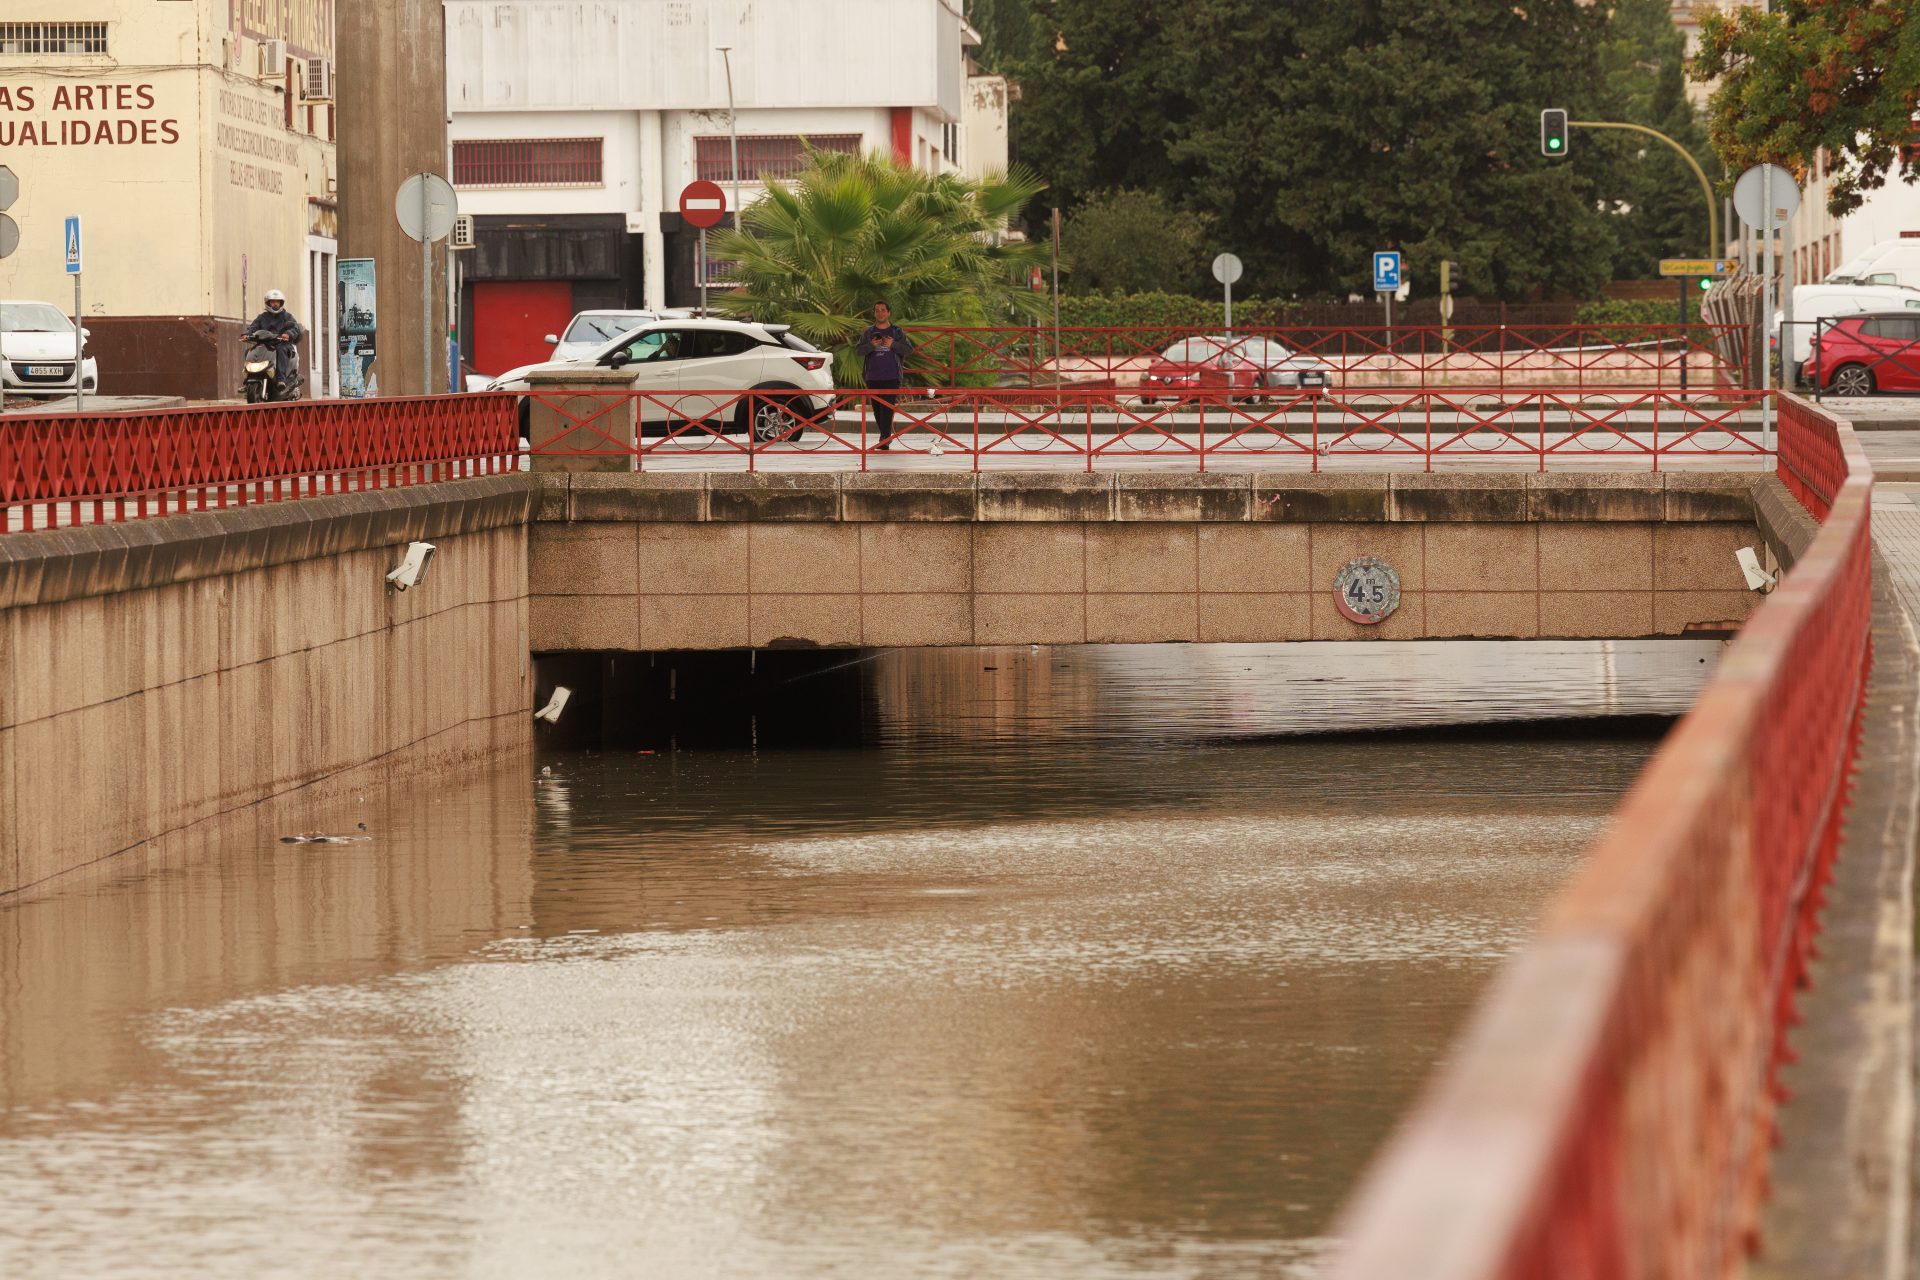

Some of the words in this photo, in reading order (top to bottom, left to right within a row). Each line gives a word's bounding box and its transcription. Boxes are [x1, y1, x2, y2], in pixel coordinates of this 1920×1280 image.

[52, 84, 155, 111] ARTES
[0, 119, 179, 146] UALIDADES
[1379, 257, 1395, 278] P
